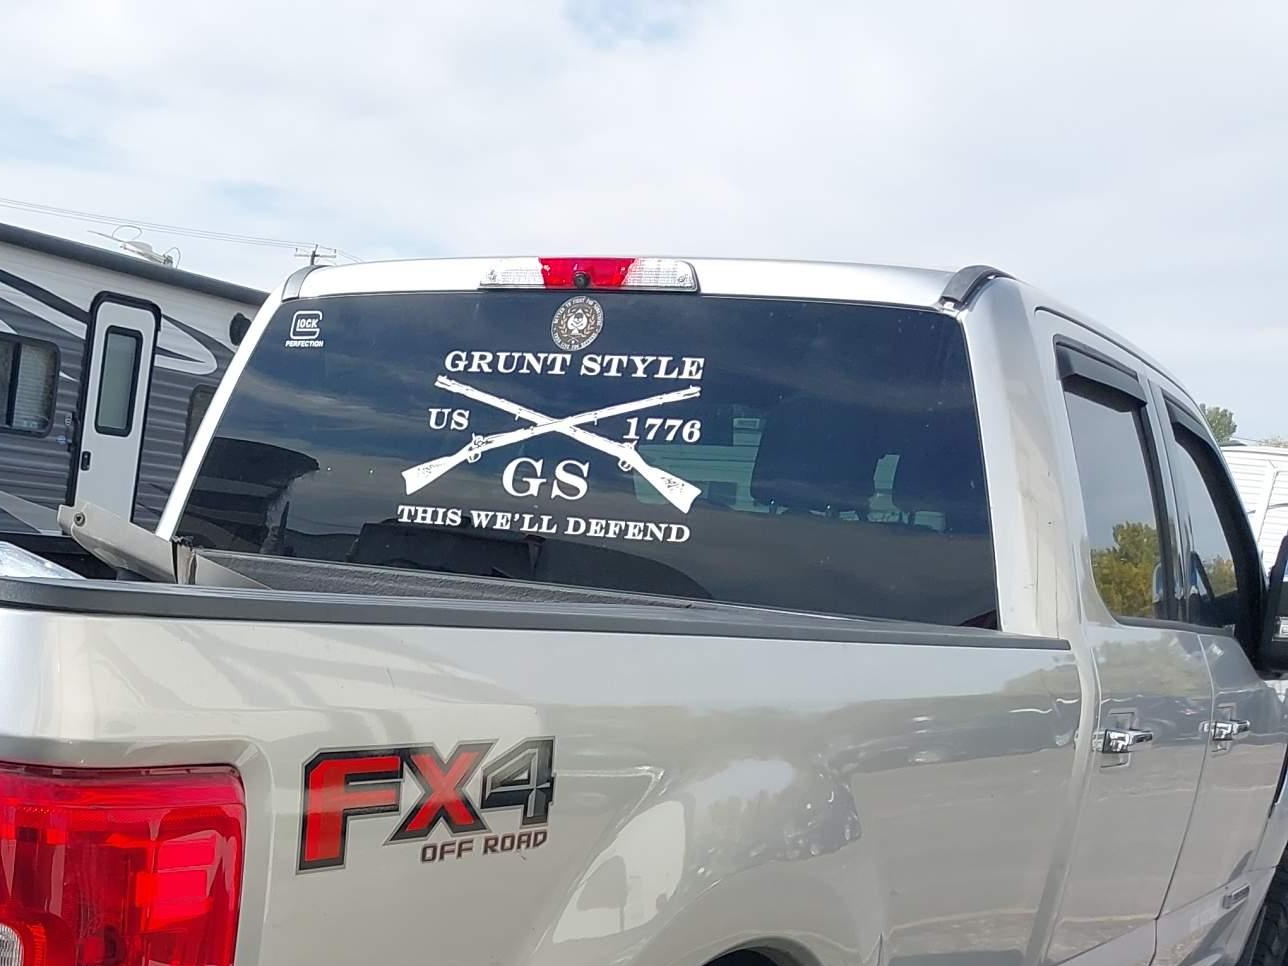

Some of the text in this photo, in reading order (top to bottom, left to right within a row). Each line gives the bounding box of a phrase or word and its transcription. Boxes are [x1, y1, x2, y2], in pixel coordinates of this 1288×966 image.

[285, 340, 324, 348] PERFECTION
[444, 351, 705, 380] GRUNT STYLE
[428, 408, 470, 430] US
[622, 418, 702, 443] 1776
[502, 457, 590, 500] GS
[397, 505, 690, 543] THIS WE'LL DEFEND
[296, 736, 555, 875] FX4
[420, 831, 548, 863] OFF ROAD
